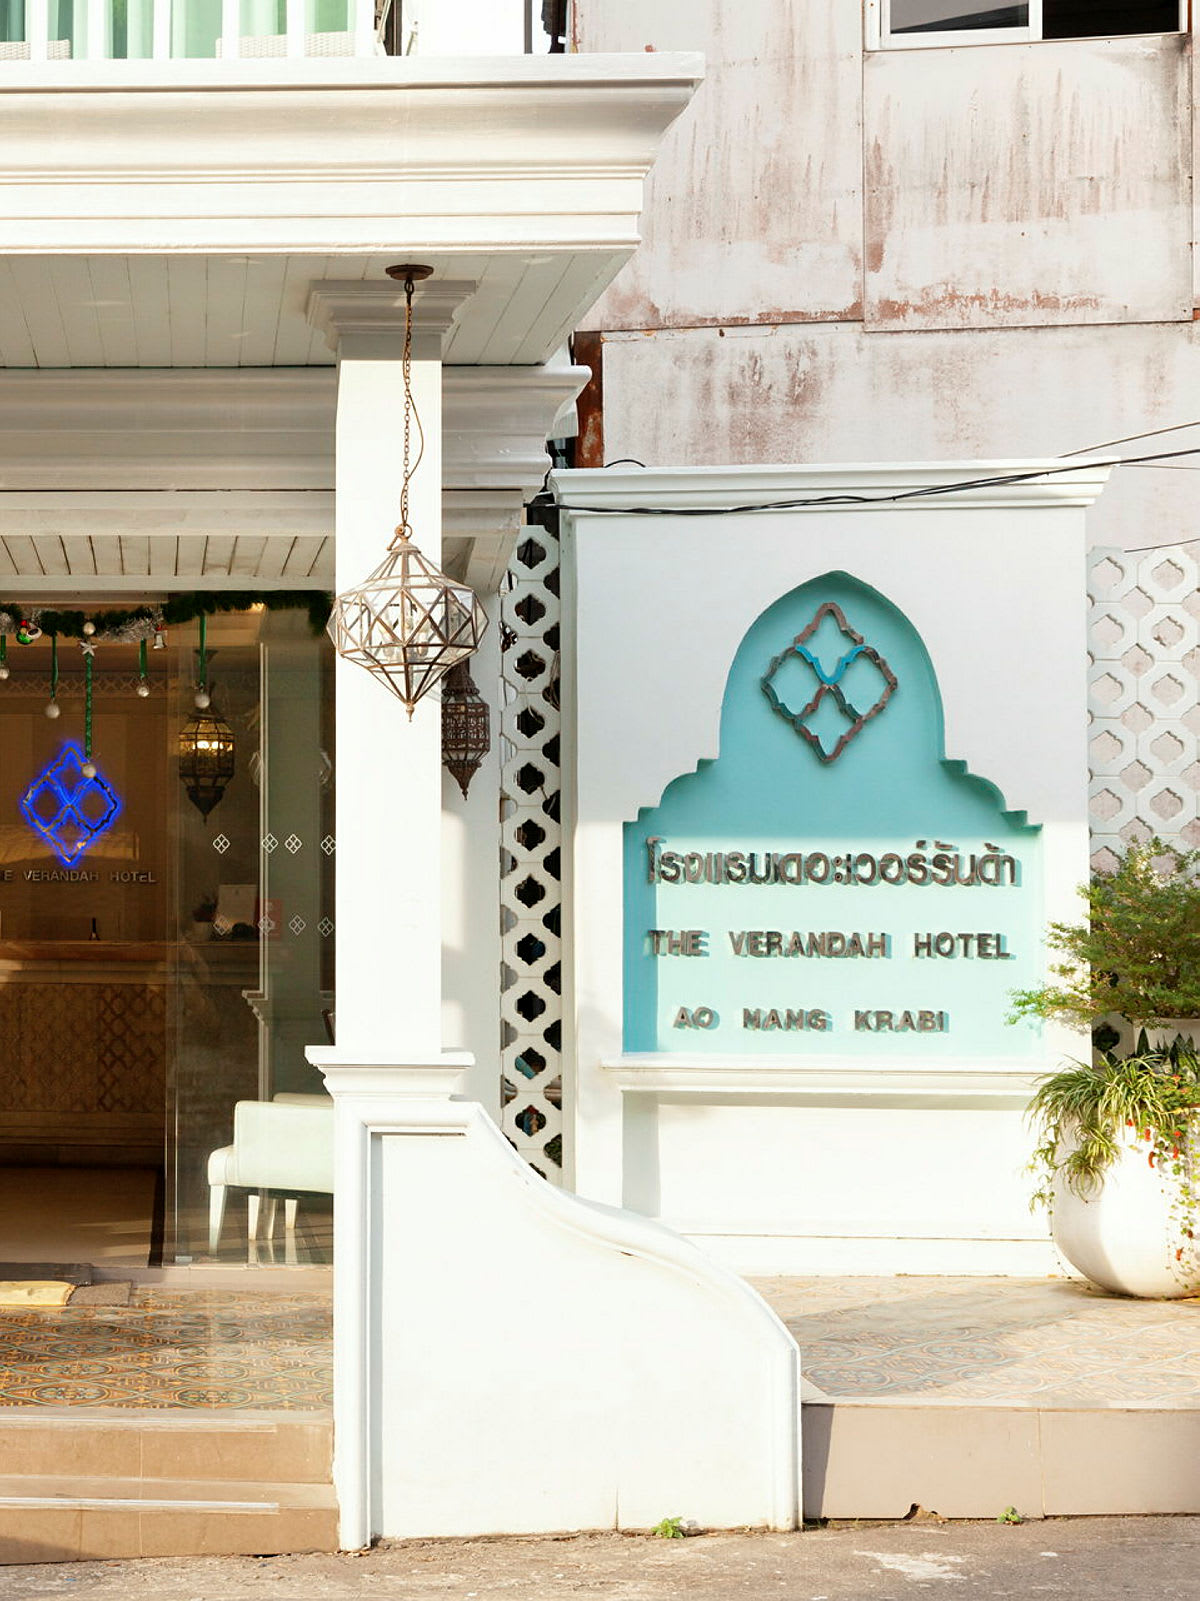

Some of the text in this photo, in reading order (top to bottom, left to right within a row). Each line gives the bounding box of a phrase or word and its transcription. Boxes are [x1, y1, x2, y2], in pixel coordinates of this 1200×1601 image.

[23, 870, 100, 883] VERANDAH
[110, 871, 157, 884] HOTEL
[648, 929, 1011, 959] THE VERANDAH HOTEL
[673, 1006, 945, 1032] AO NANG KRABI
